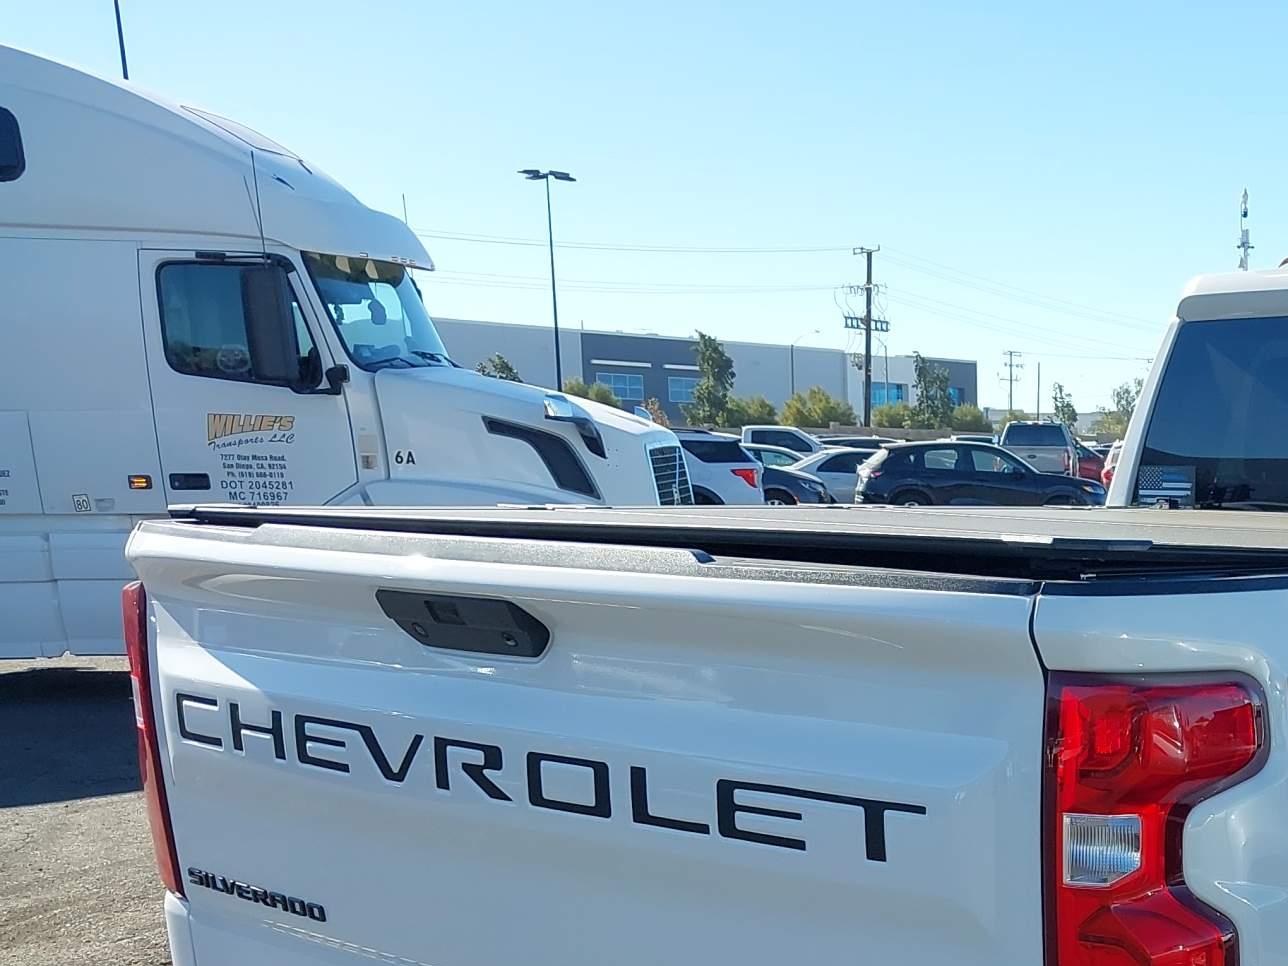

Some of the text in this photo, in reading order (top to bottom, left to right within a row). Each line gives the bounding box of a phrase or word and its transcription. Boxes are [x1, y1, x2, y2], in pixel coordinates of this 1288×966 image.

[207, 413, 295, 442] WILLIE'S
[208, 433, 295, 451] Transports LLC
[395, 450, 416, 465] 6A
[220, 480, 294, 490] DOT 2045281
[228, 491, 289, 501] MC 716967
[76, 499, 89, 511] 80
[176, 692, 927, 862] CHEVROLET
[187, 867, 327, 922] SILVERADO
